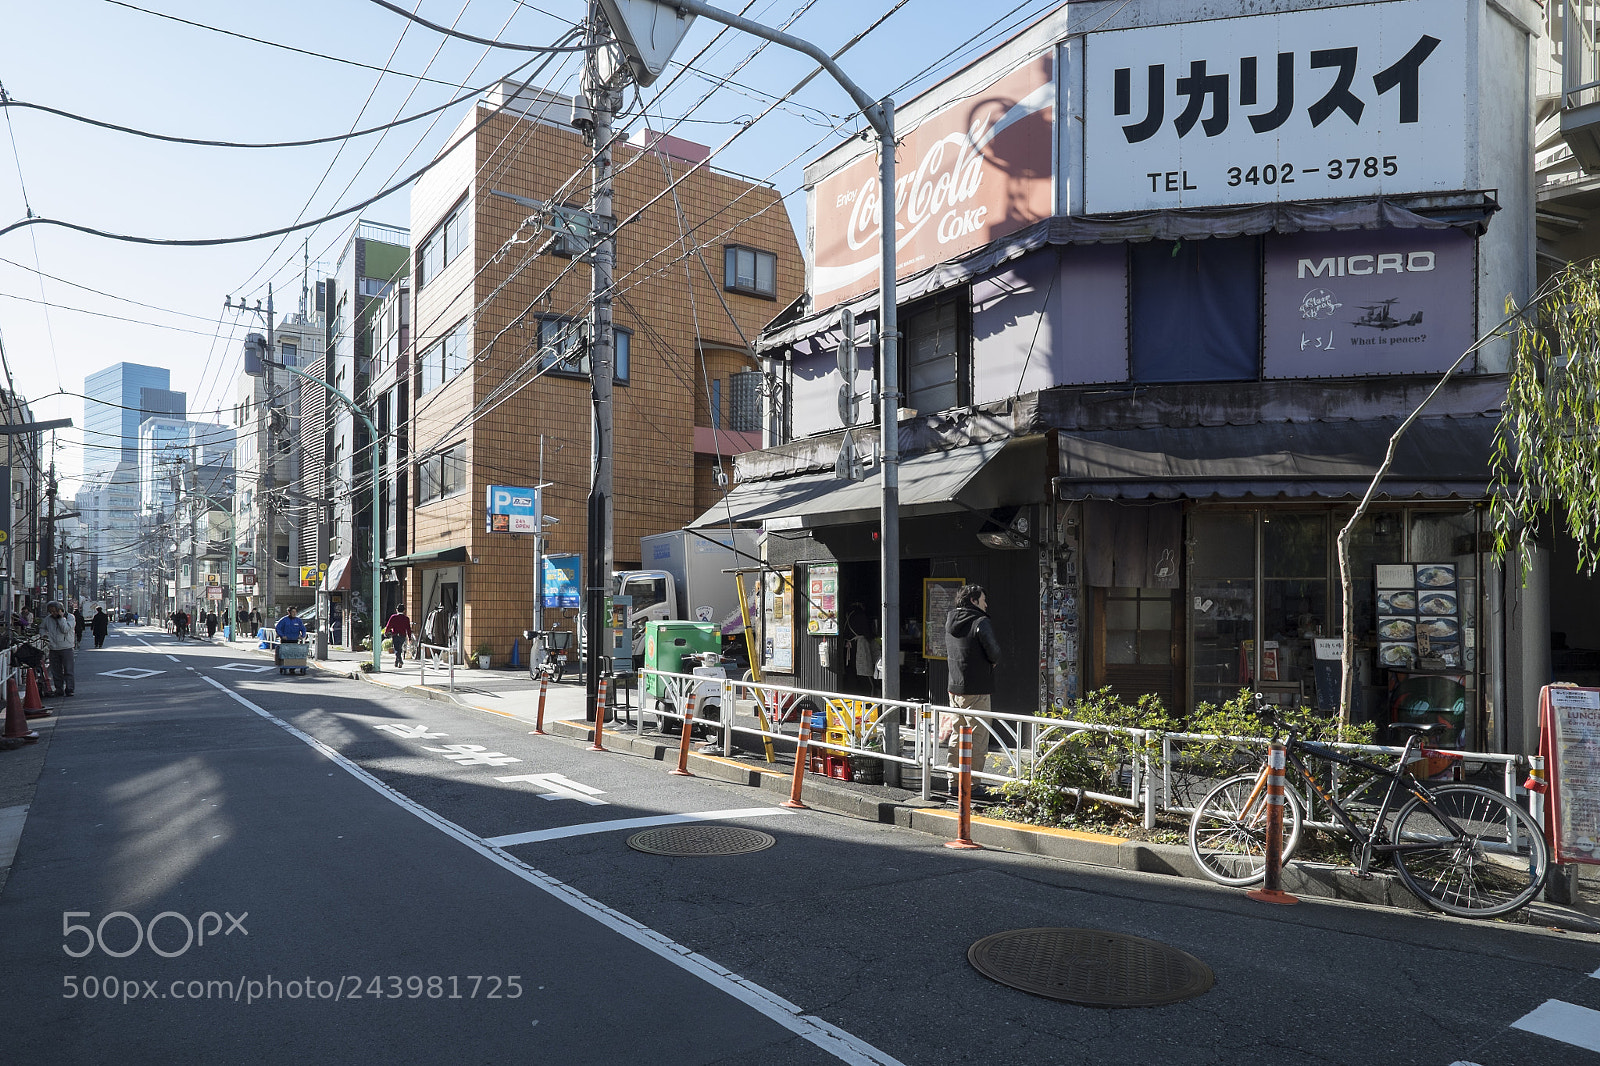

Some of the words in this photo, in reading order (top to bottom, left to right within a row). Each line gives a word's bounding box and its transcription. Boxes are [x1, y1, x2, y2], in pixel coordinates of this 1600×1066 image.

[1114, 34, 1442, 144] リカリスイ
[1146, 170, 1197, 193] TEL
[937, 206, 987, 244] Coke
[1297, 251, 1436, 279] MICRO
[1350, 337, 1375, 346] What
[1379, 336, 1388, 345] is
[1390, 334, 1427, 346] peace?
[494, 491, 511, 514] P
